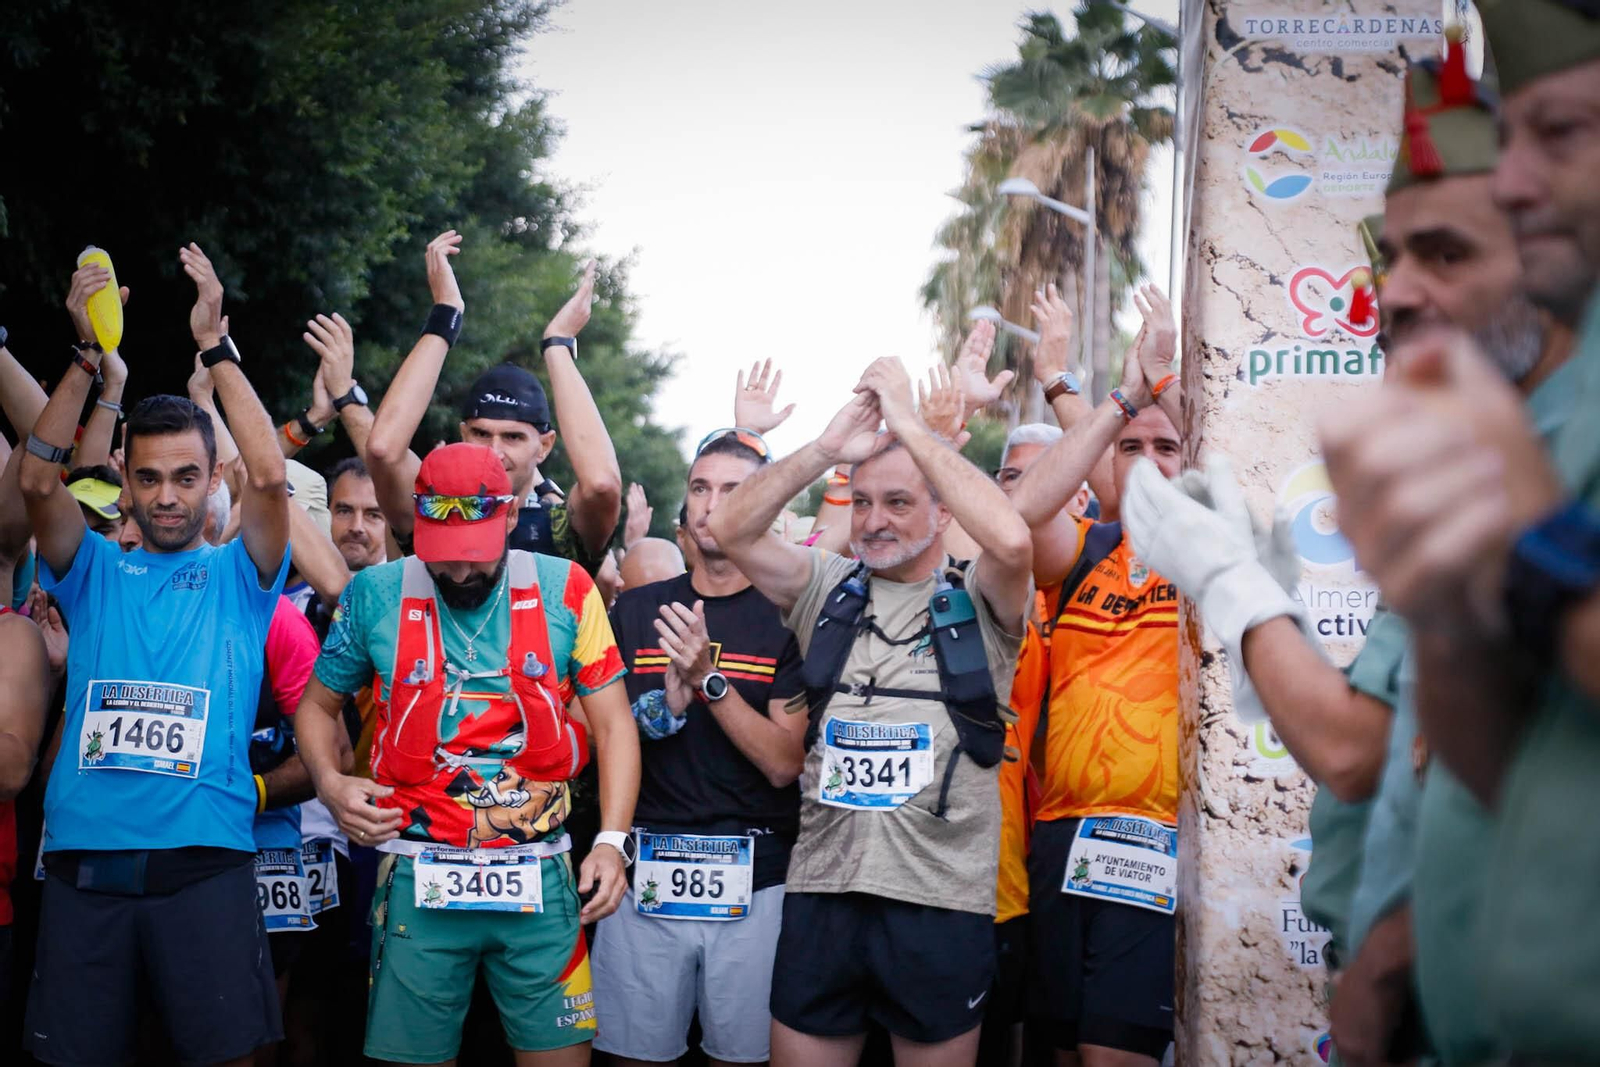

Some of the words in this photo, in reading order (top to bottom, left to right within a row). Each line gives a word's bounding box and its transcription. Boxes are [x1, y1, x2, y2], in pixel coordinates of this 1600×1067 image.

[1297, 39, 1332, 50] centro
[1338, 38, 1394, 51] comercial
[1323, 172, 1359, 184] Región
[1077, 582, 1100, 606] LA
[102, 685, 119, 699] LA
[109, 716, 186, 754] 1466
[842, 756, 911, 788] 3341
[653, 837, 668, 850] LA
[1095, 853, 1167, 877] AYUNTAMIENTO
[1105, 864, 1116, 877] DE
[1119, 867, 1153, 883] VIATOR
[446, 870, 524, 897] 3405
[671, 868, 725, 898] 985
